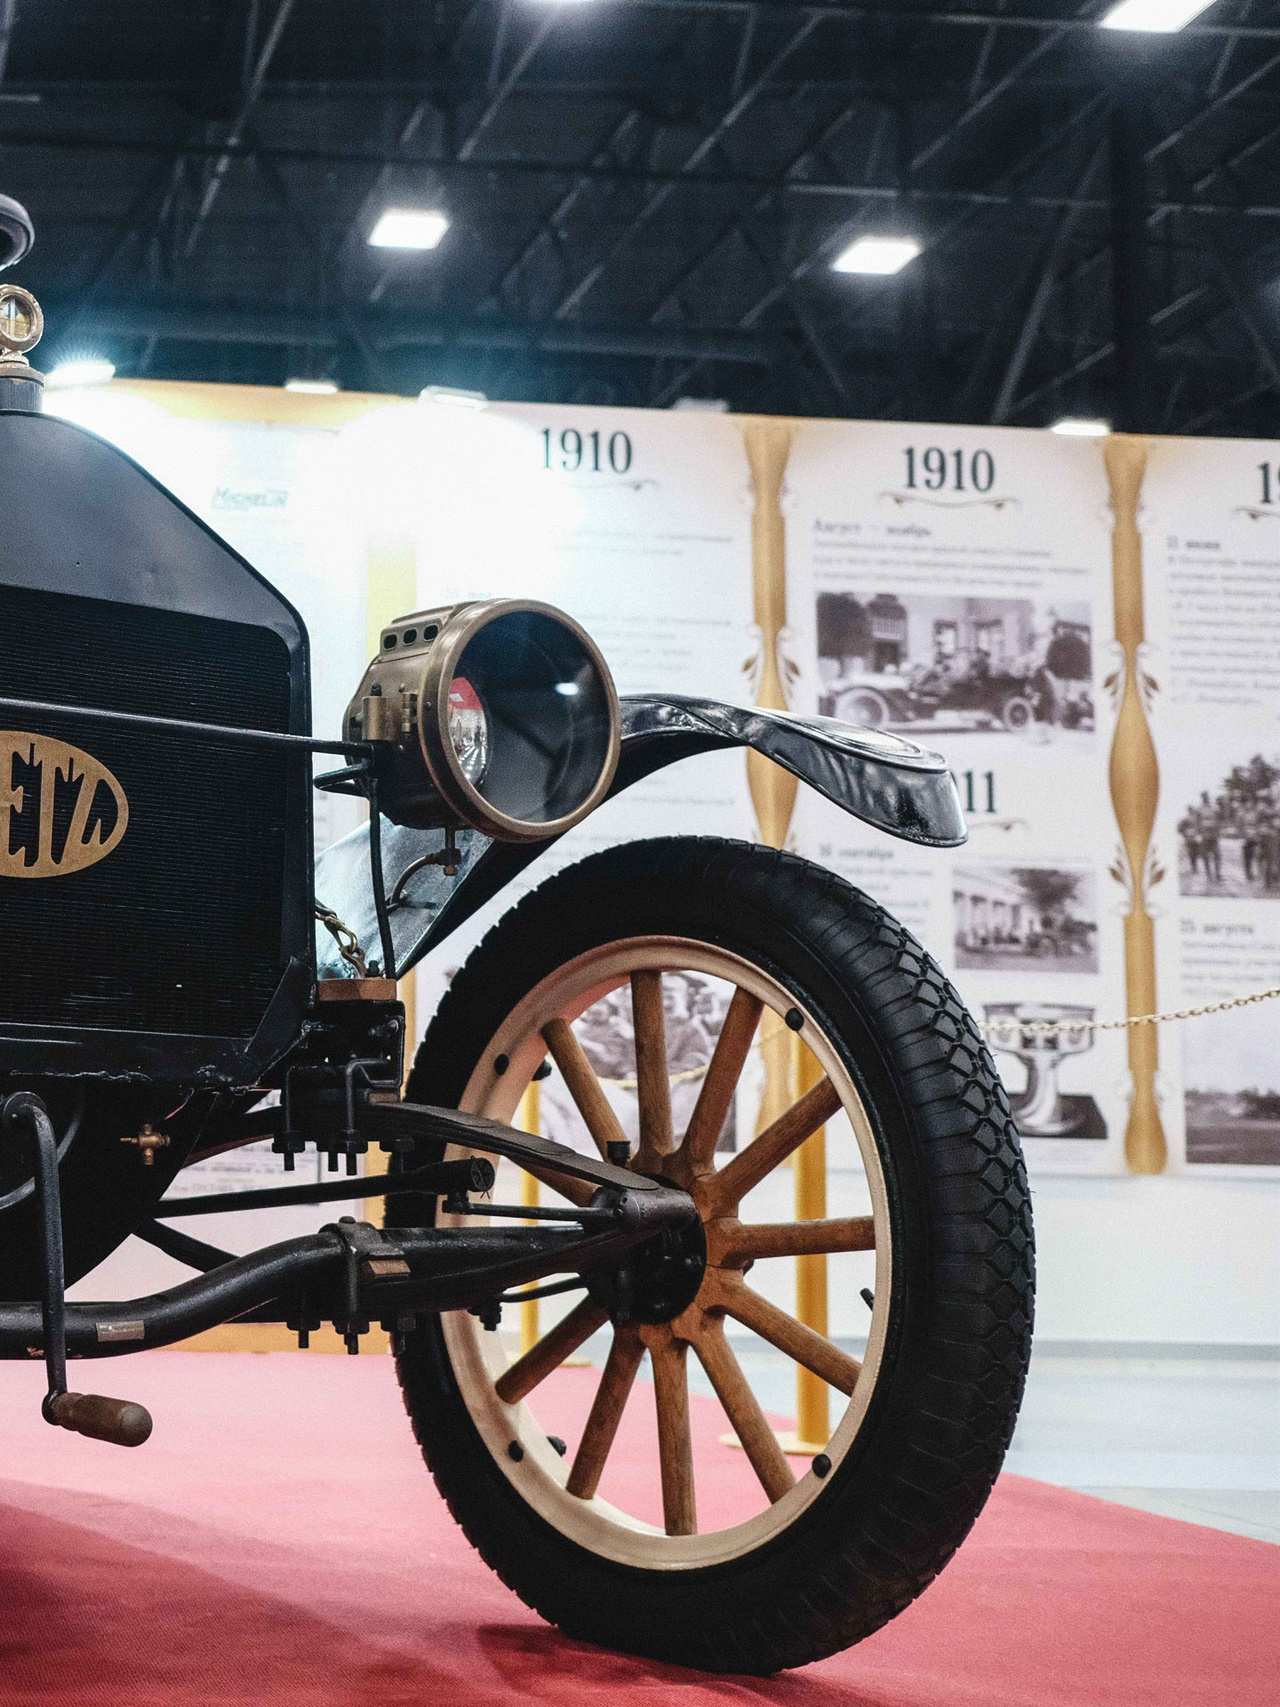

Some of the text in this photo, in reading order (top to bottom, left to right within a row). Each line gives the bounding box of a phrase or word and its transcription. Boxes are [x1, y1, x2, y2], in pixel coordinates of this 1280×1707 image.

[541, 428, 632, 473] 1910
[904, 446, 995, 492] 1910
[1257, 461, 1280, 504] 1
[950, 768, 998, 815] 11
